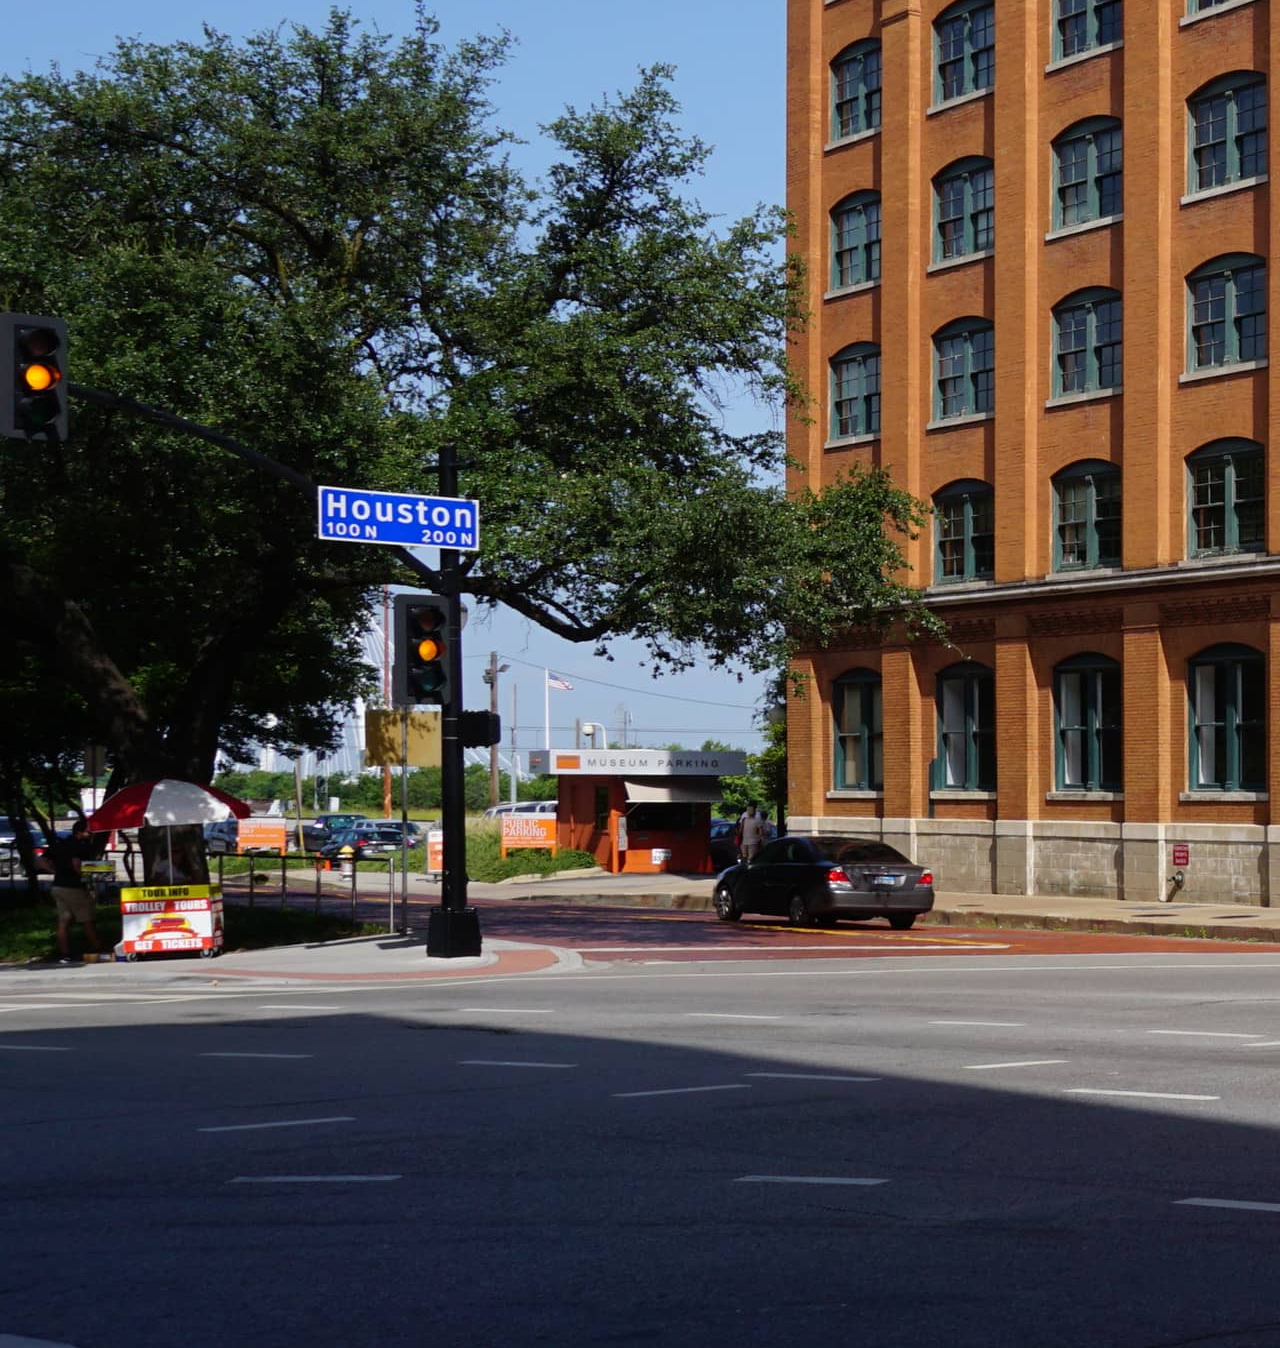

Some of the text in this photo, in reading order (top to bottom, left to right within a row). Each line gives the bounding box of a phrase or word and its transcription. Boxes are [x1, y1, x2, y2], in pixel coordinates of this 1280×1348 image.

[327, 493, 472, 529] Houston
[326, 522, 377, 539] 100 N
[421, 529, 473, 545] 200 N
[587, 758, 719, 768] MUSEUM PARKING
[503, 819, 539, 828] PUBLIC
[503, 827, 547, 837] PARKING
[142, 888, 189, 898] TOUR INFO
[124, 899, 208, 912] TROLLEY TOURS
[134, 938, 203, 950] GET TICKETS
